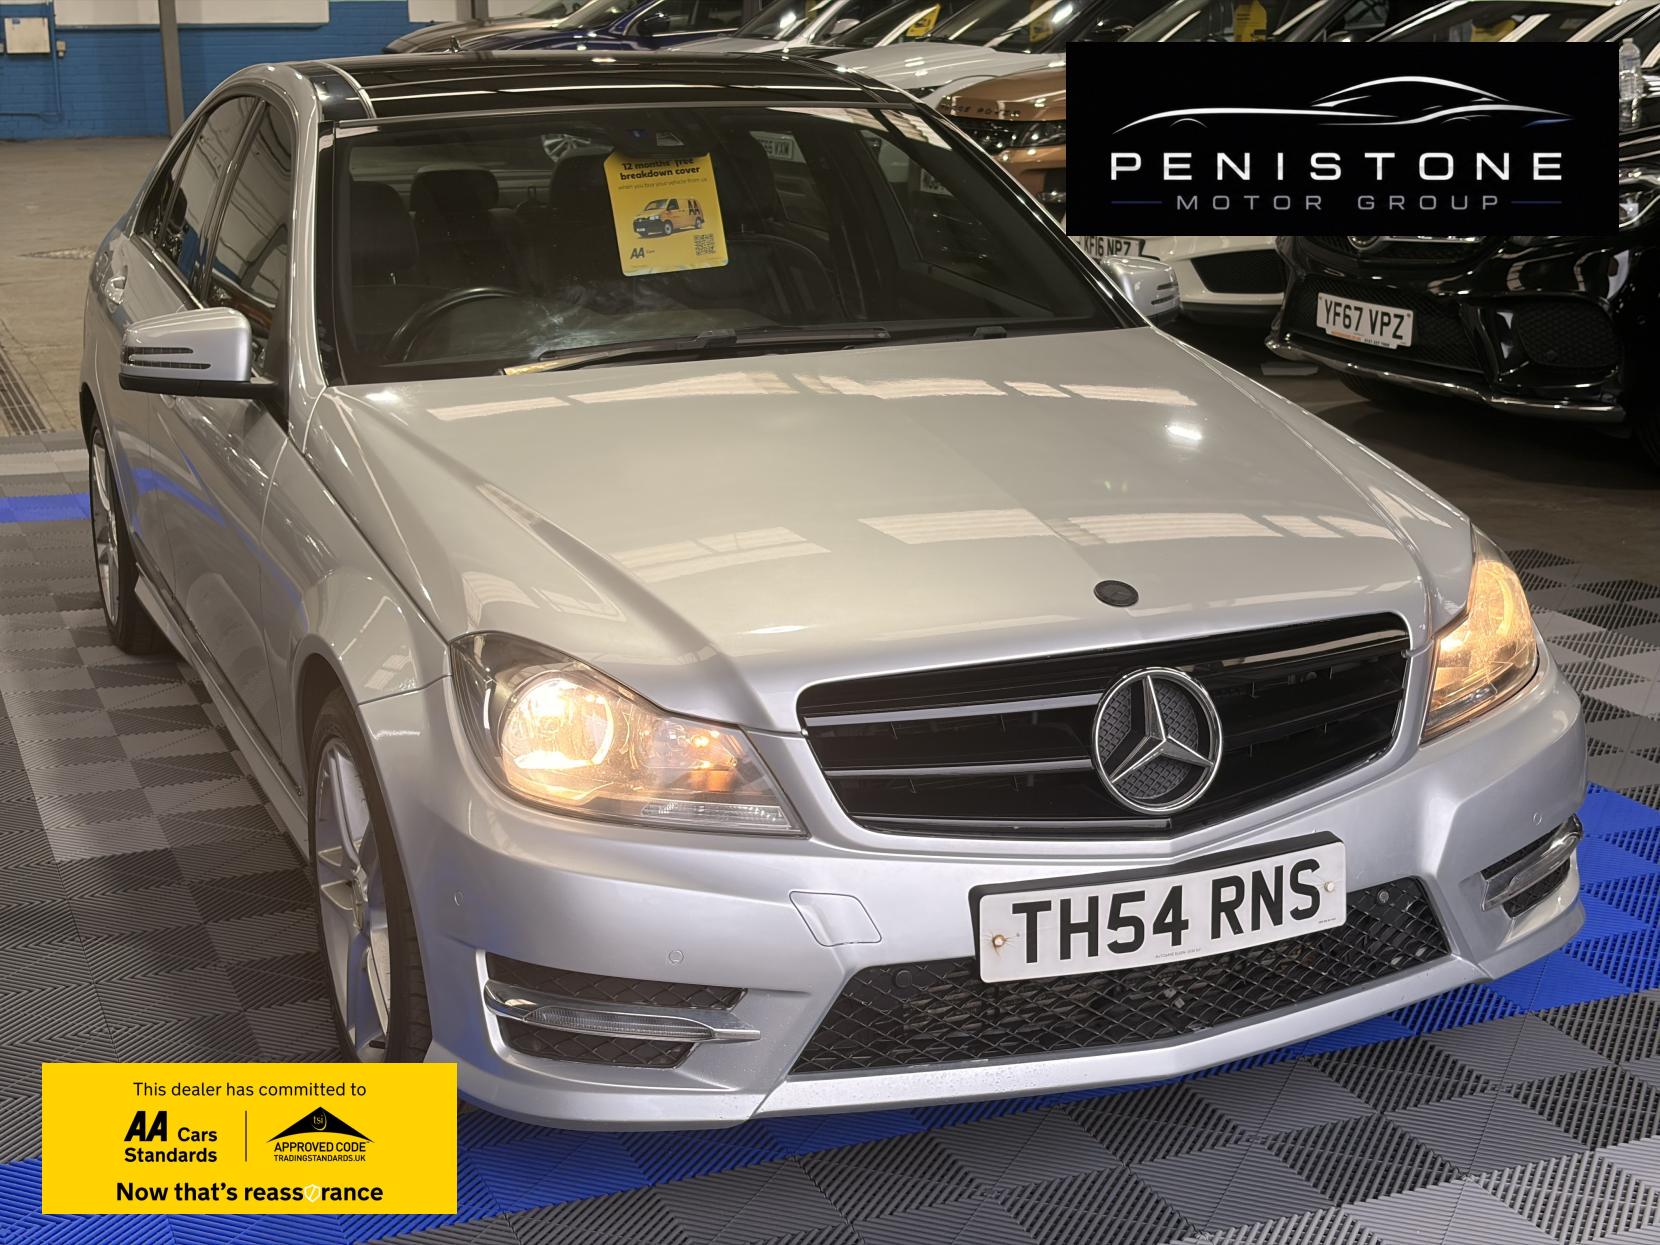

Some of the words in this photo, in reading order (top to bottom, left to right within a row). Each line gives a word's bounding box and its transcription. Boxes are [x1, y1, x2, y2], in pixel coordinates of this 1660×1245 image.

[620, 169, 673, 180] breakdown
[675, 166, 700, 175] cover
[622, 162, 633, 171] 12
[630, 248, 645, 259] AA
[1325, 299, 1363, 331] YF67
[1369, 309, 1405, 340] VPZ
[1012, 885, 1189, 964] TH54
[1211, 859, 1321, 940] RNS
